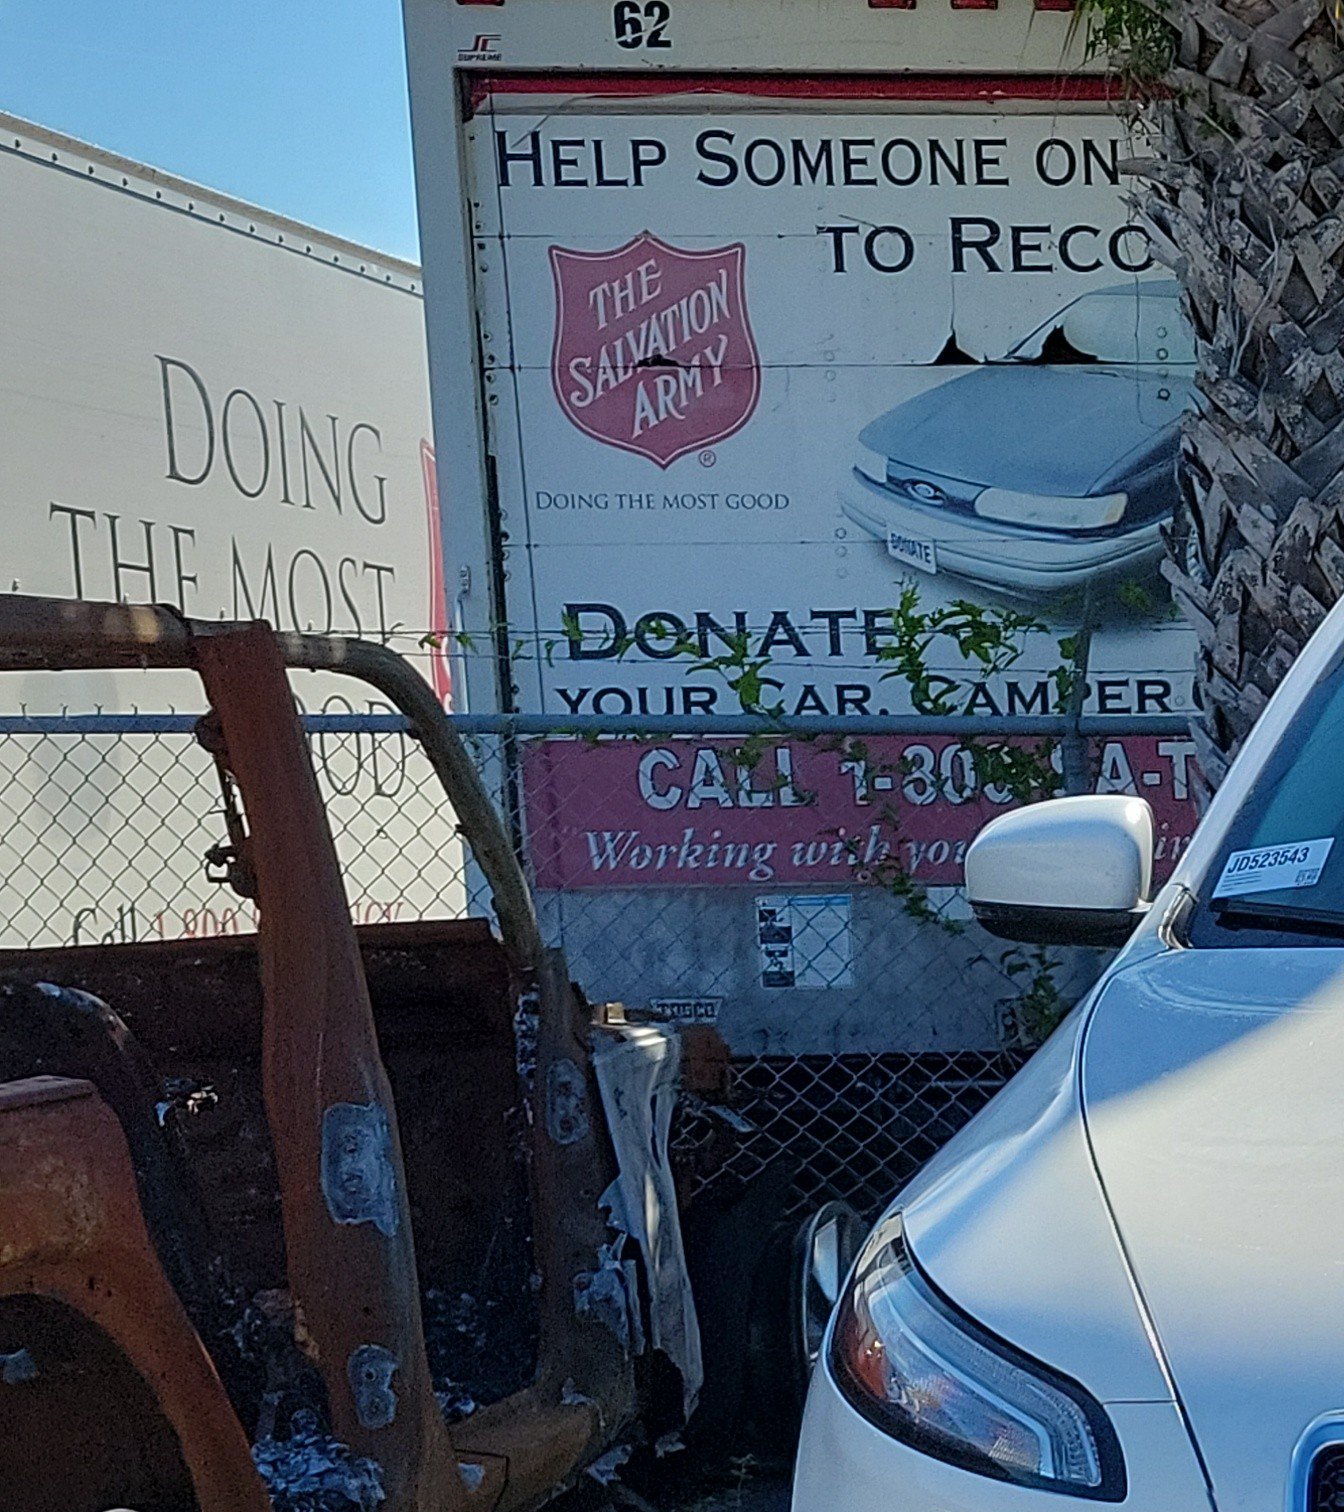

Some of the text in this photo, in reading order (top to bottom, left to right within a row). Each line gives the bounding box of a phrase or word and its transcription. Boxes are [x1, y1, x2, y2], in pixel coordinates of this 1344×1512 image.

[614, 1, 672, 48] 62
[1035, 138, 1119, 187] ON
[816, 224, 915, 273] TO
[589, 258, 662, 331] THE
[569, 268, 731, 408] SALVATION
[632, 334, 728, 439] ARMY
[637, 747, 812, 810] CALL
[585, 827, 778, 881] Working
[1228, 847, 1310, 874] JD523543
